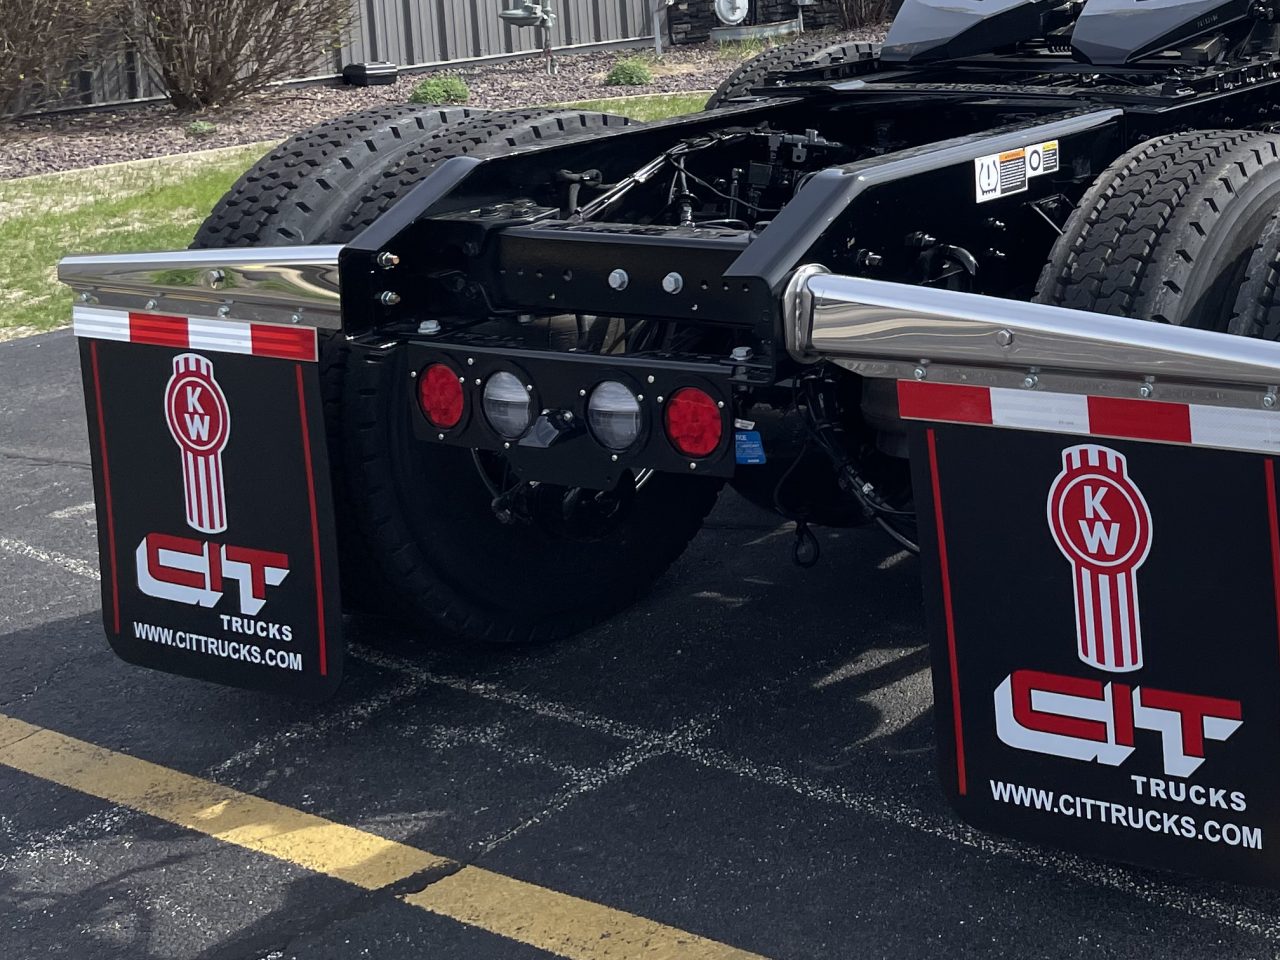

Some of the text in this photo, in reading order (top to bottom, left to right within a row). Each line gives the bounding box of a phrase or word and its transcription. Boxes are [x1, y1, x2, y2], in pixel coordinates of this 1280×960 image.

[186, 385, 205, 414] K
[183, 413, 211, 442] W
[1083, 485, 1111, 521] K
[1078, 519, 1121, 556] W
[135, 532, 290, 616] CIT
[133, 621, 303, 671] WWW.CITTRUCKS.COM
[219, 614, 293, 642] TRUCKS
[993, 669, 1244, 778] CIT
[1130, 774, 1247, 812] TRUCKS
[989, 779, 1263, 850] WWW.CITTRUCKS.COM
